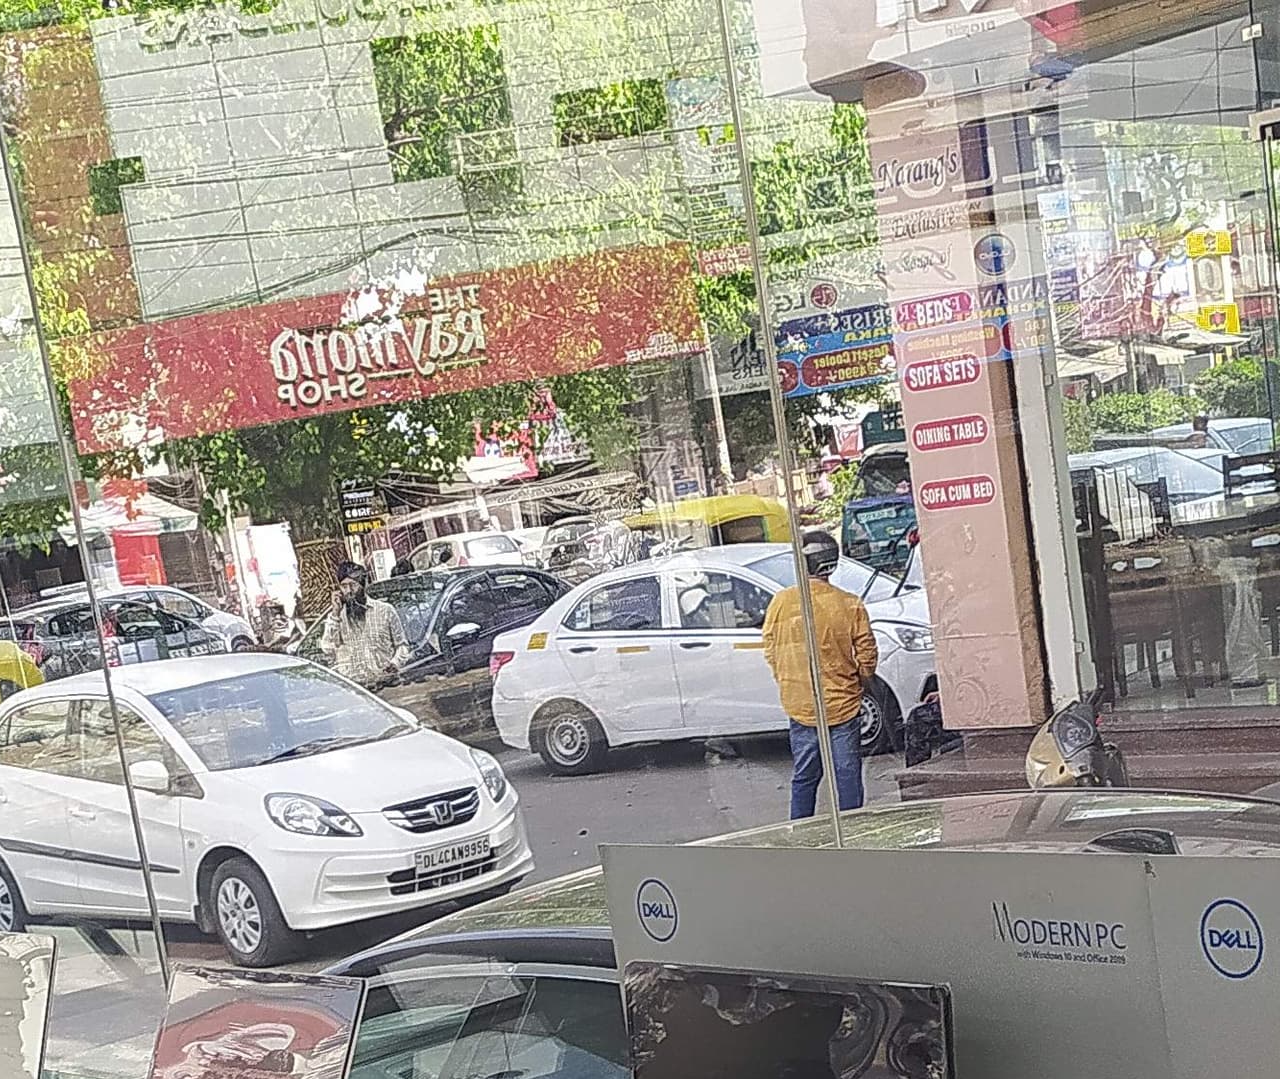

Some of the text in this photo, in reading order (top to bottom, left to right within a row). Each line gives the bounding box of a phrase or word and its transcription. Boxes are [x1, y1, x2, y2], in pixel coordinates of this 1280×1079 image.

[878, 147, 958, 193] Narang's
[917, 300, 952, 327] BEDS
[909, 358, 976, 388] SOFA SETS
[915, 420, 985, 447] DINING TABLE
[922, 481, 993, 505] SOFA CUM BED
[642, 903, 673, 920] DELL
[992, 901, 1127, 950] MODERN PC
[1208, 929, 1257, 951] DELL
[1017, 950, 1031, 959] with
[1031, 950, 1063, 961] Windows
[1064, 952, 1072, 961] 10
[1073, 952, 1086, 962] and
[1087, 953, 1108, 963] Office
